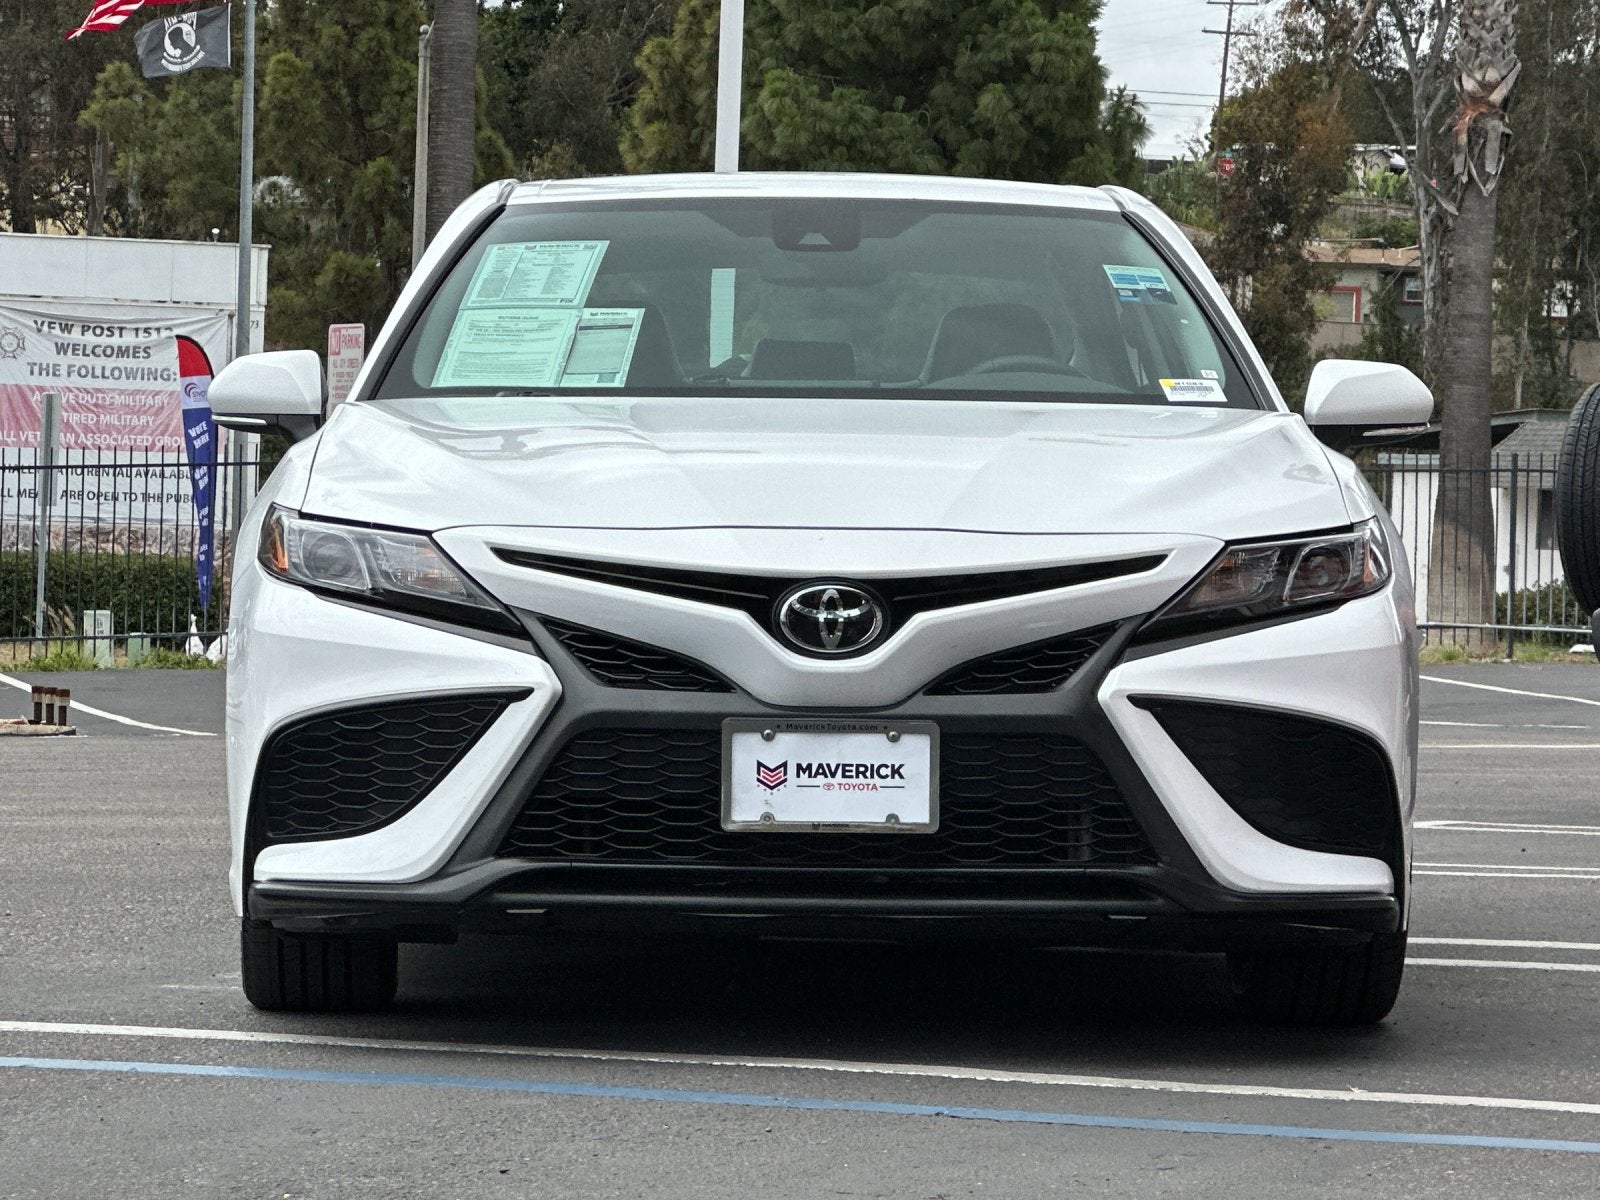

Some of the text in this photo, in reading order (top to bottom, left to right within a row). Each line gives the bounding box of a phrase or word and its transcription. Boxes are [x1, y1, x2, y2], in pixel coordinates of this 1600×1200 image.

[80, 323, 129, 339] POST
[54, 341, 151, 360] WELCOMES
[26, 361, 178, 382] THE FOLLOWING:
[32, 390, 169, 407] AVE DUTY MILITARY
[62, 413, 155, 427] TIRED MILITARY
[19, 430, 75, 444] VETAN
[78, 433, 152, 447] ASSOCIATED
[134, 468, 191, 480] AVAILABL
[122, 491, 138, 502] TO
[796, 762, 906, 780] MAVERICK
[837, 782, 878, 792] TOYOTA
